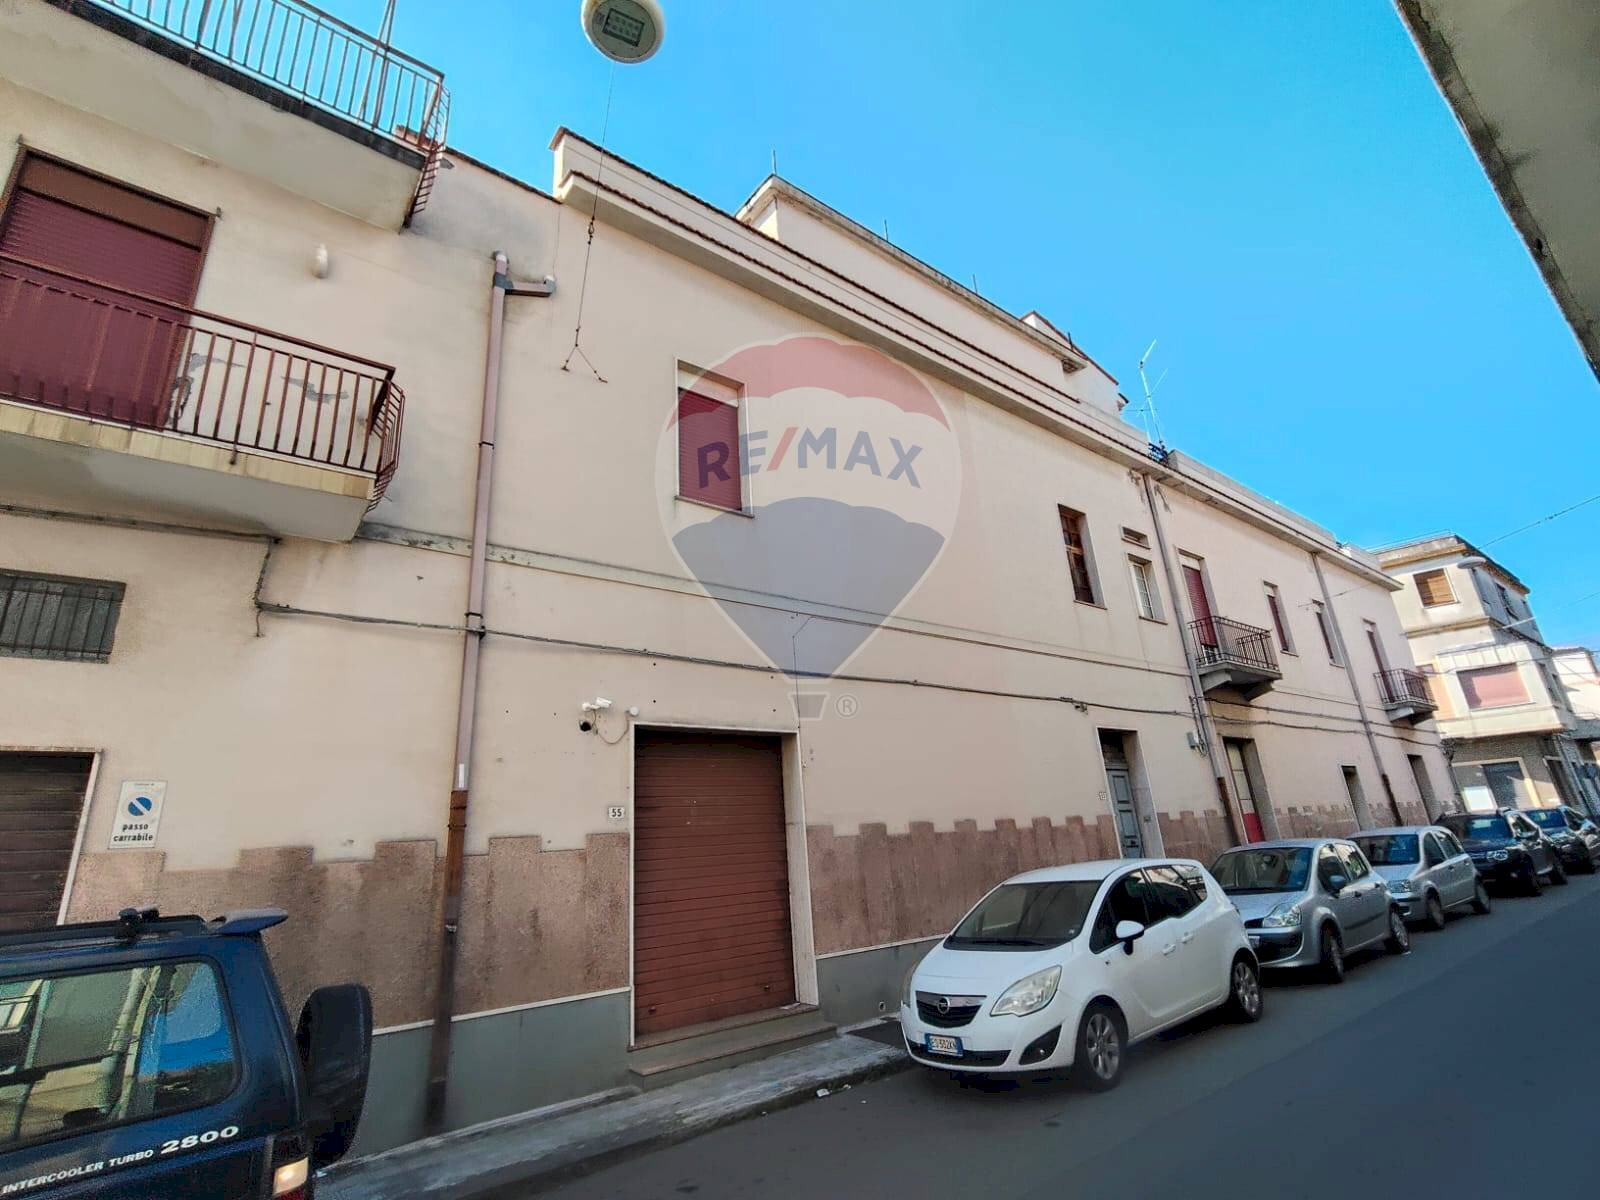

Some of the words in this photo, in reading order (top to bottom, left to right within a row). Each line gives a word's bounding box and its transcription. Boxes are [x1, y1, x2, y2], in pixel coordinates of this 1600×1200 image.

[611, 807, 622, 818] 55
[122, 823, 149, 832] passo
[113, 833, 153, 842] carrabile
[2, 1161, 104, 1194] INTERCOOLER
[109, 1149, 154, 1166] TURBO
[160, 1125, 239, 1154] 2800
